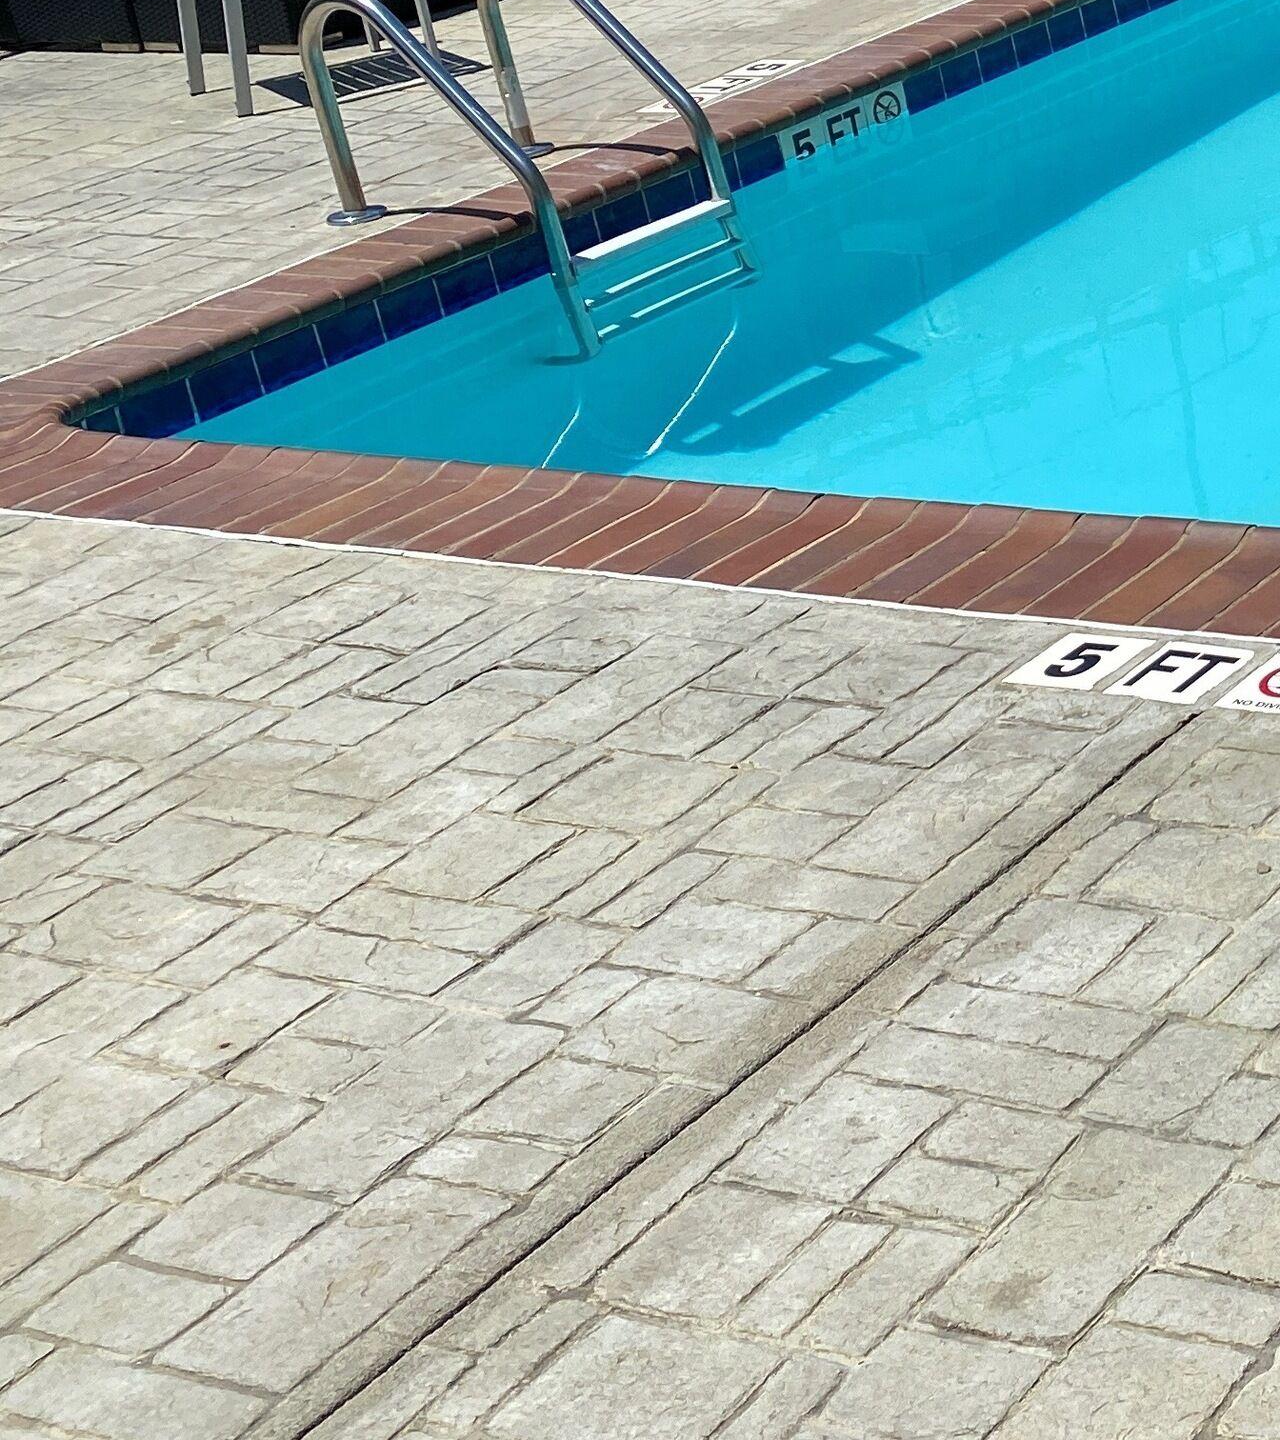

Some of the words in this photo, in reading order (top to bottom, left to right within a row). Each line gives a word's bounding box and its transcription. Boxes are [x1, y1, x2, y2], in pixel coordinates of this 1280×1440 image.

[746, 63, 787, 71] 5
[699, 77, 753, 92] FT
[791, 128, 816, 160] 5
[826, 106, 861, 147] FT
[1043, 642, 1120, 678] 5
[1122, 649, 1241, 694] FT
[1232, 698, 1253, 707] NO
